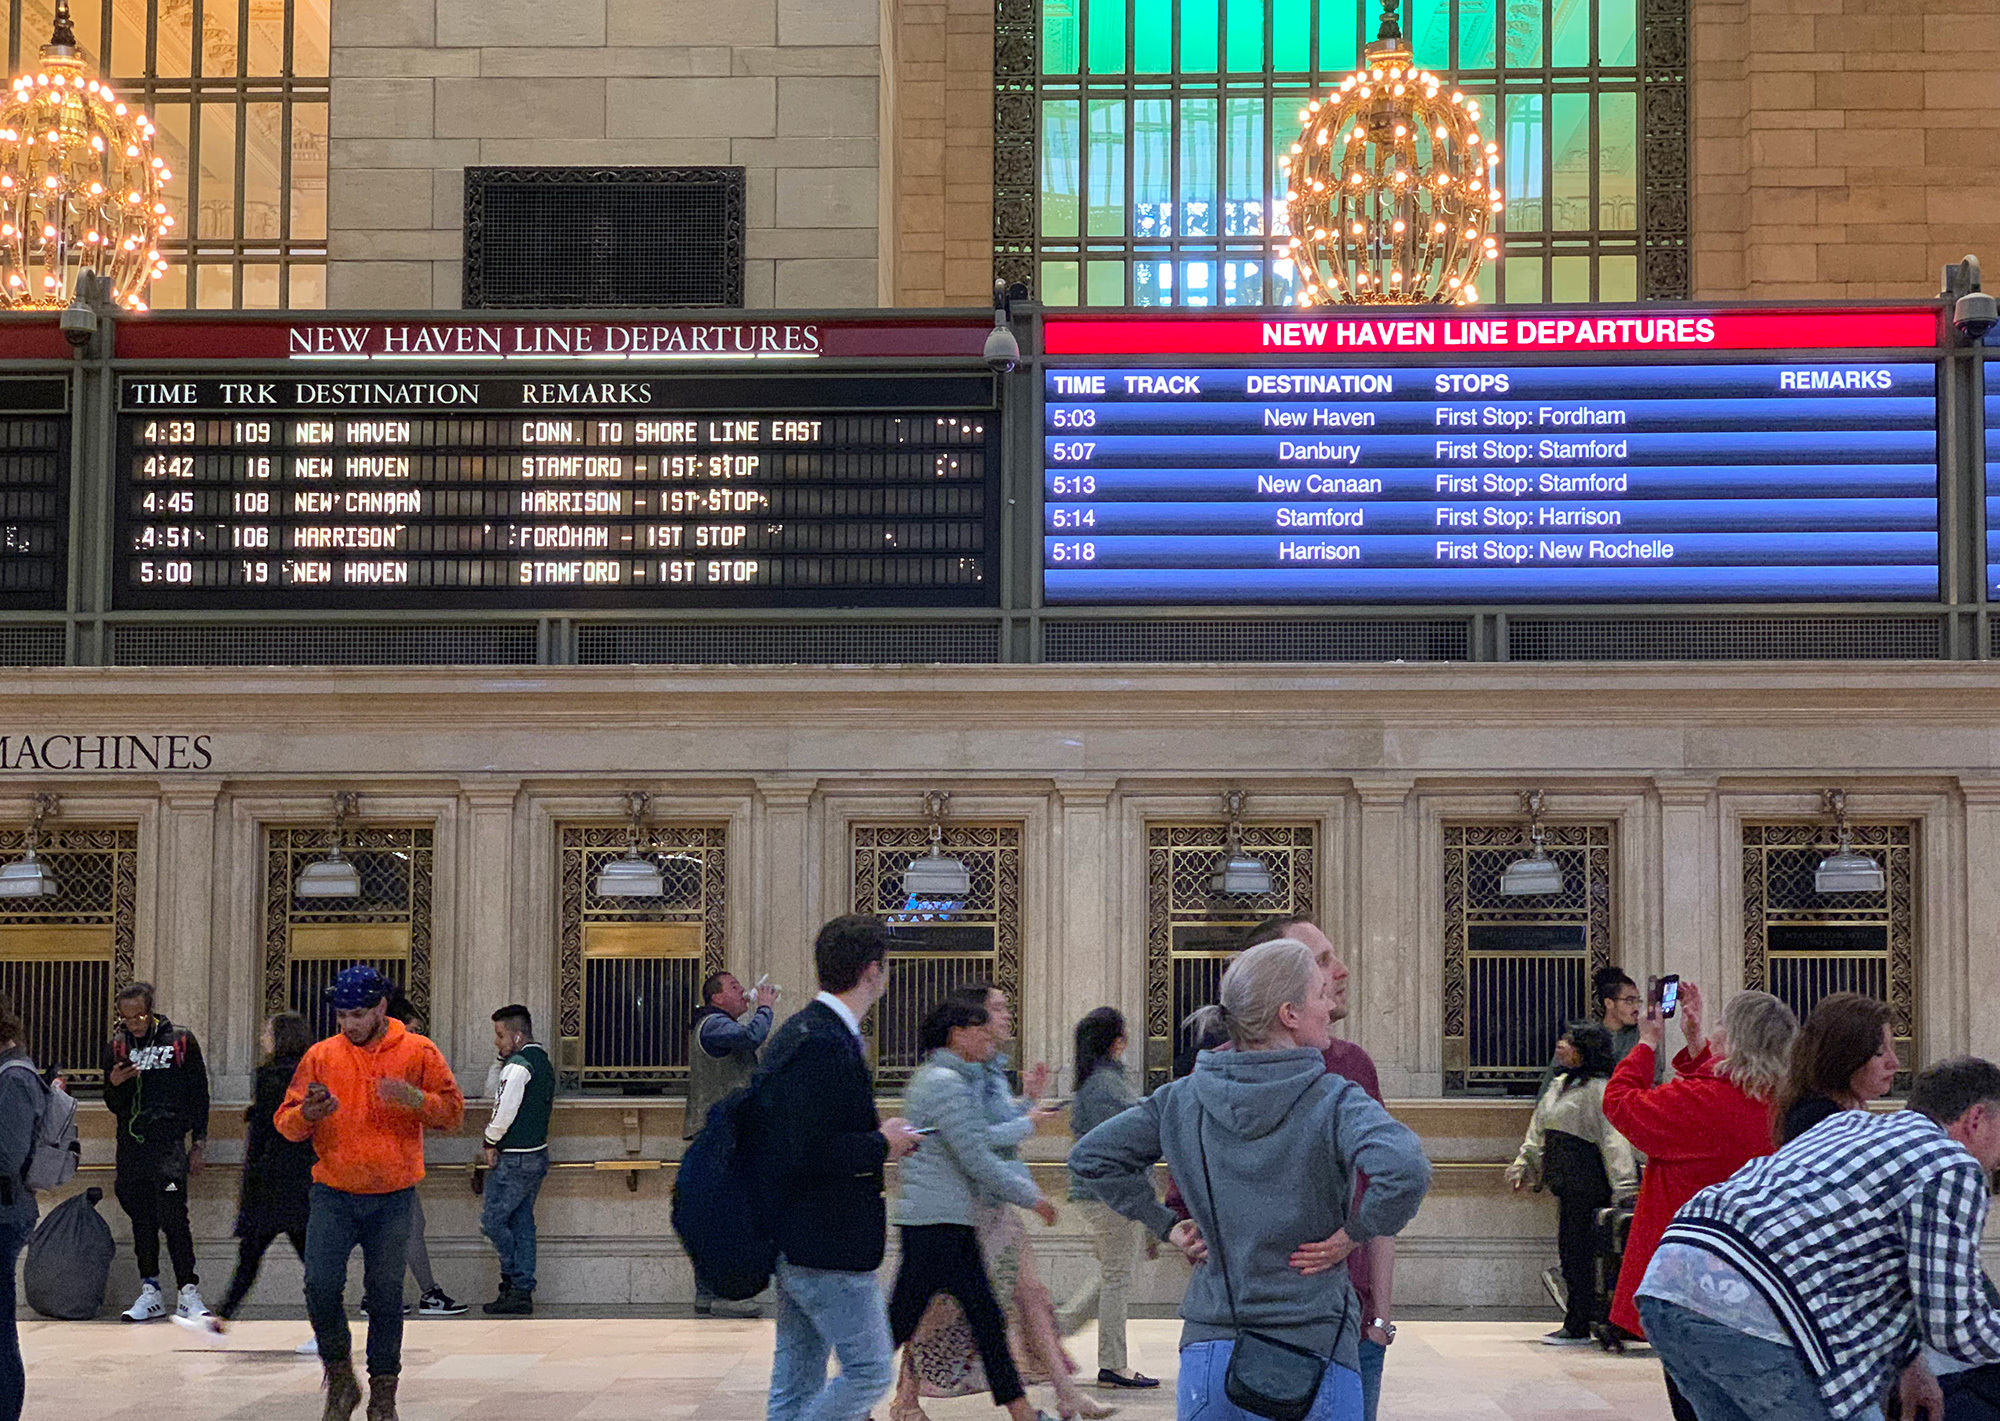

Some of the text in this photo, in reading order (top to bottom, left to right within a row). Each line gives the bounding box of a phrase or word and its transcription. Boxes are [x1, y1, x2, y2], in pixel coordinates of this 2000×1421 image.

[289, 327, 370, 354] NEW
[384, 326, 503, 354] HAVEN
[515, 327, 593, 353] LINE
[1262, 319, 1715, 347] NEW HAVEN LINE DEPARTURES
[131, 382, 653, 405] TIME TRK DESTINATION REMARKS
[1053, 370, 1892, 394] TIME TRACK DESTINATION STOPS REMARKS
[1053, 406, 1626, 430] 5:03 New Haven First Stop: Fordham
[144, 421, 822, 444] 4:33 109 NEW HAVEN CONN. TO SHORE LINE EAST
[1053, 440, 1628, 465] 5:07 Danbury First Stop: Stamford
[143, 457, 195, 478] 4:42
[246, 457, 271, 478] 16
[295, 458, 333, 478] NEW
[345, 457, 410, 478] HAVEN
[522, 457, 622, 478] STAMFORD
[660, 456, 694, 478] 1ST
[709, 455, 760, 478] STOP
[1053, 473, 1628, 497] 5:13 New Canaan First Stop: Stamford
[142, 492, 194, 513] 4:45
[233, 492, 270, 513] 108
[294, 492, 332, 513] NEW
[345, 491, 421, 513] CANAAN
[521, 491, 621, 513] HARRISON
[660, 492, 696, 513] 1ST
[708, 491, 759, 513] STOP
[1053, 507, 1621, 531] 5:14 Stamford First Stop: Harrison
[141, 526, 190, 548] 4:51
[233, 527, 270, 548] 106
[293, 527, 396, 548] HARRISON
[520, 526, 608, 547] FORDHAM
[648, 527, 683, 547] 1ST
[696, 527, 746, 546] STOP
[1053, 540, 1674, 564] 5:18 Harrison First Stop: New Rochelle
[140, 562, 192, 583] 5:00
[245, 562, 269, 583] 19
[293, 562, 331, 583] NEW
[344, 562, 408, 583] HAVEN
[520, 562, 621, 583] STAMFORD
[660, 562, 696, 583] 1ST
[708, 562, 758, 583] STOP
